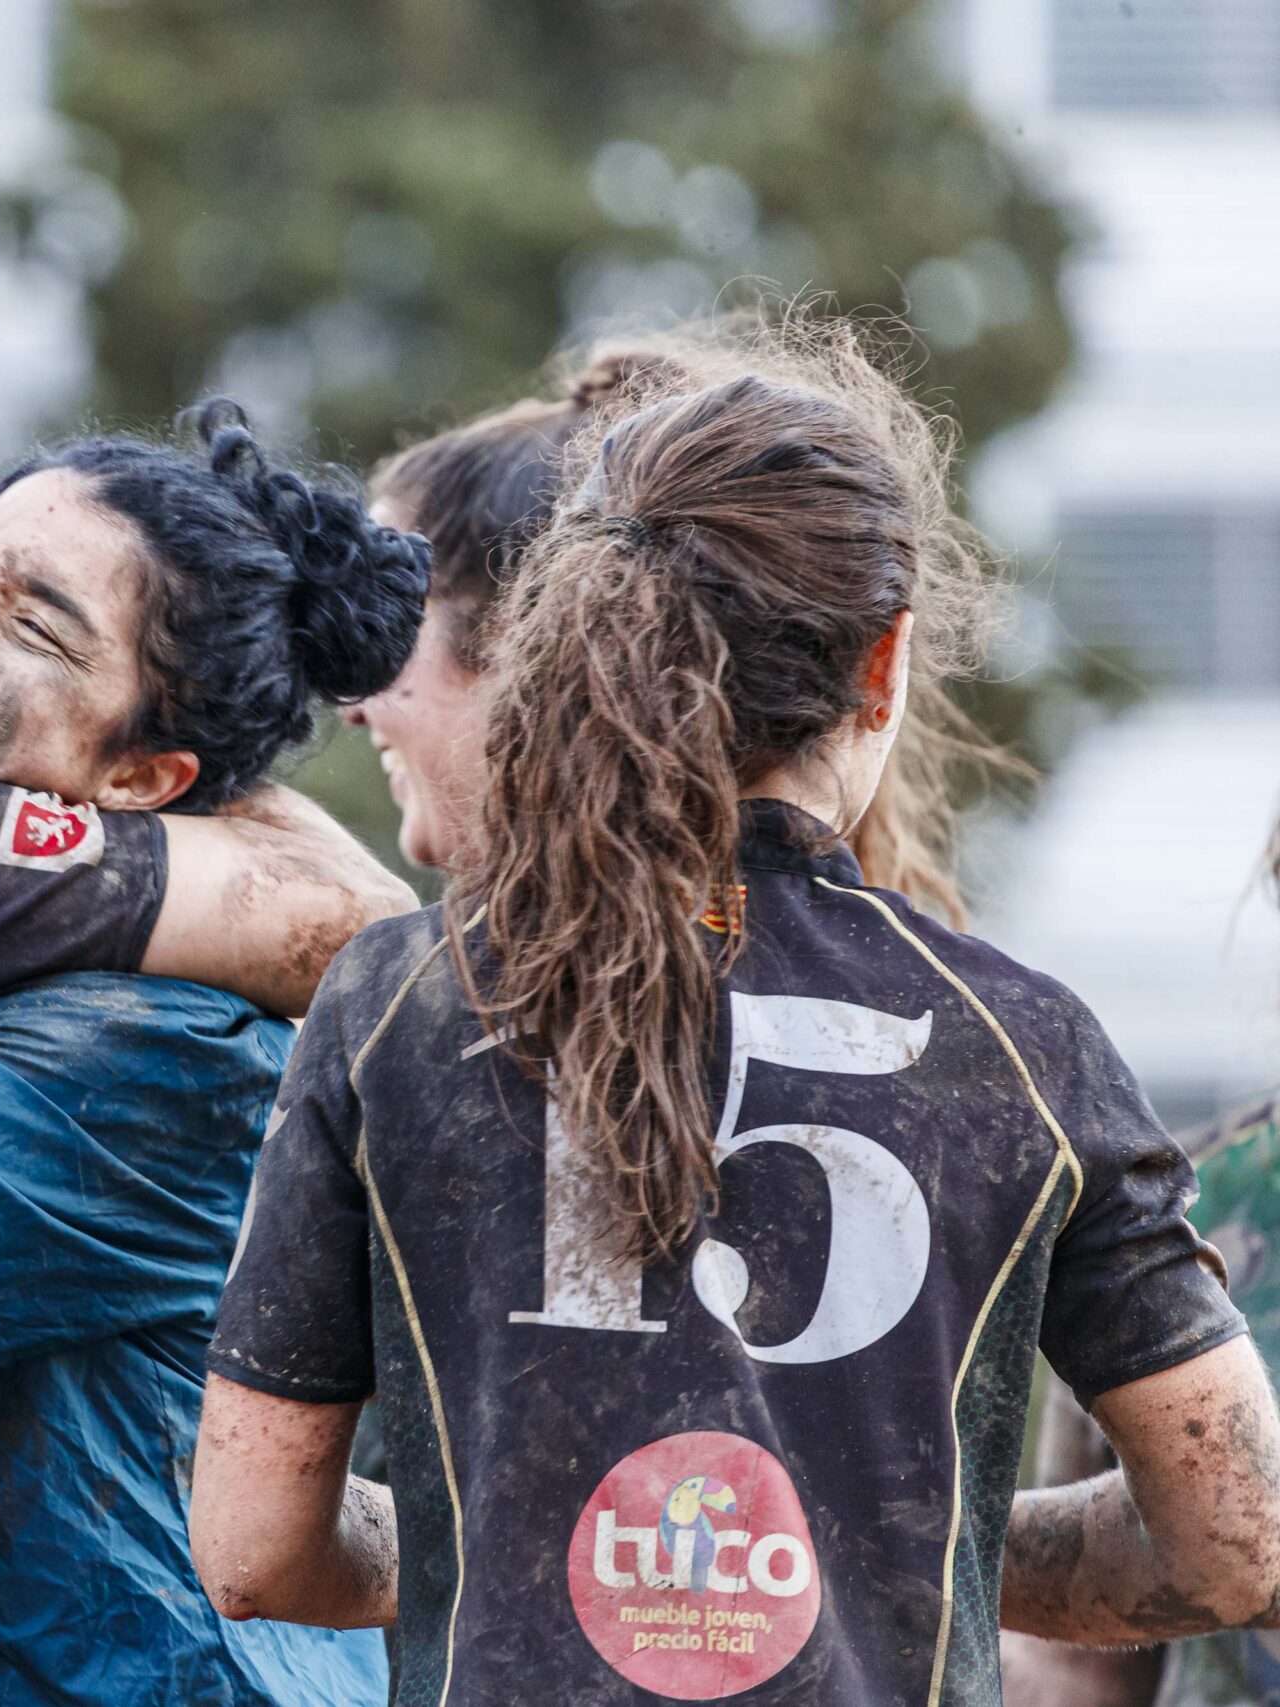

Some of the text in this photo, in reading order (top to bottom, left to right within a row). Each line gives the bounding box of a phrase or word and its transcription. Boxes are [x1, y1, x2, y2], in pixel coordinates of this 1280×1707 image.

[460, 990, 934, 1365] 15
[592, 1508, 812, 1598] tuco
[620, 1601, 773, 1634] mueble joven,
[632, 1626, 756, 1655] precio fácil
